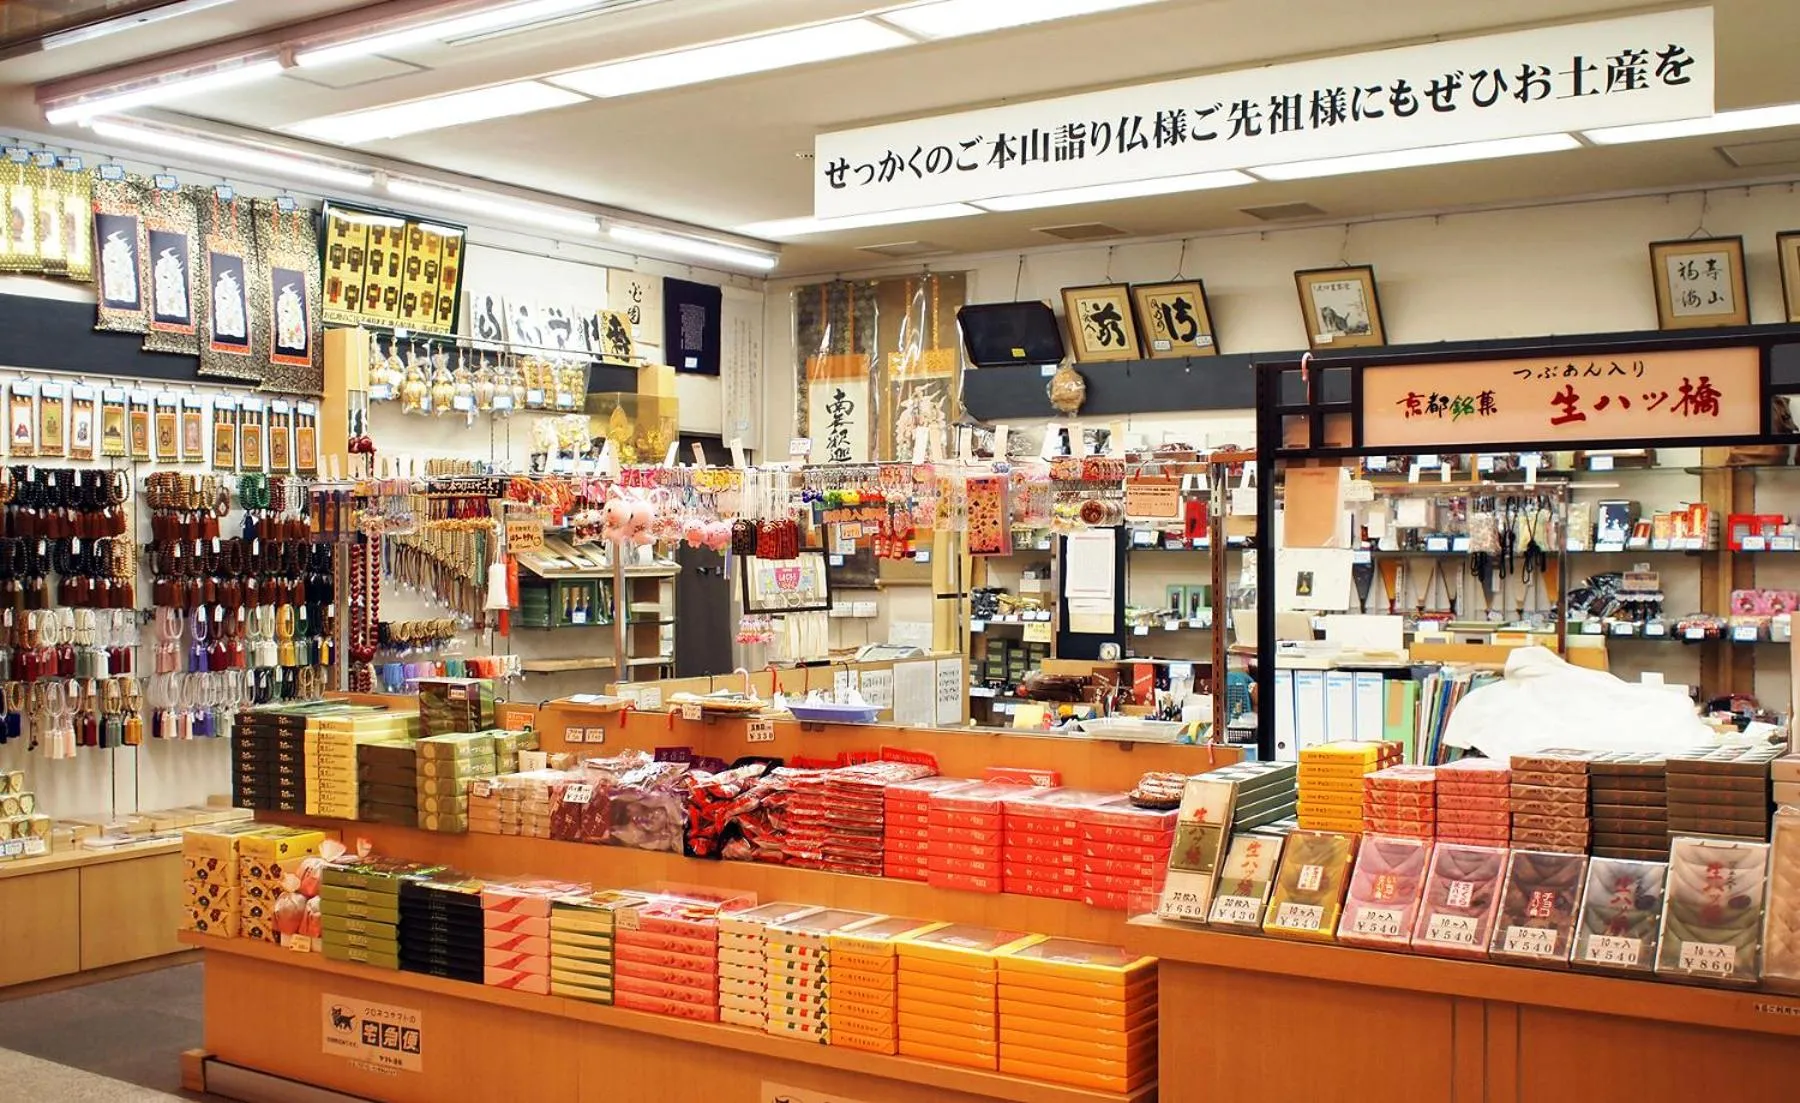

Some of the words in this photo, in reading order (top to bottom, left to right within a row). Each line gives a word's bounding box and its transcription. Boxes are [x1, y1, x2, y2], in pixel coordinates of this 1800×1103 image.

[824, 43, 1695, 190] せっかくのご本山詣り仏様ご先祖様にもぜひお土産を
[1512, 360, 1646, 379] つぶあん入り
[1165, 903, 1201, 916] ¥650
[1281, 916, 1319, 929] ¥540
[1358, 921, 1398, 934] ¥540
[1431, 929, 1473, 941] ¥540
[1509, 940, 1552, 952] ¥540
[1591, 949, 1636, 963] ¥540
[1685, 957, 1732, 972] ¥860
[363, 1022, 420, 1053] 宅急便
